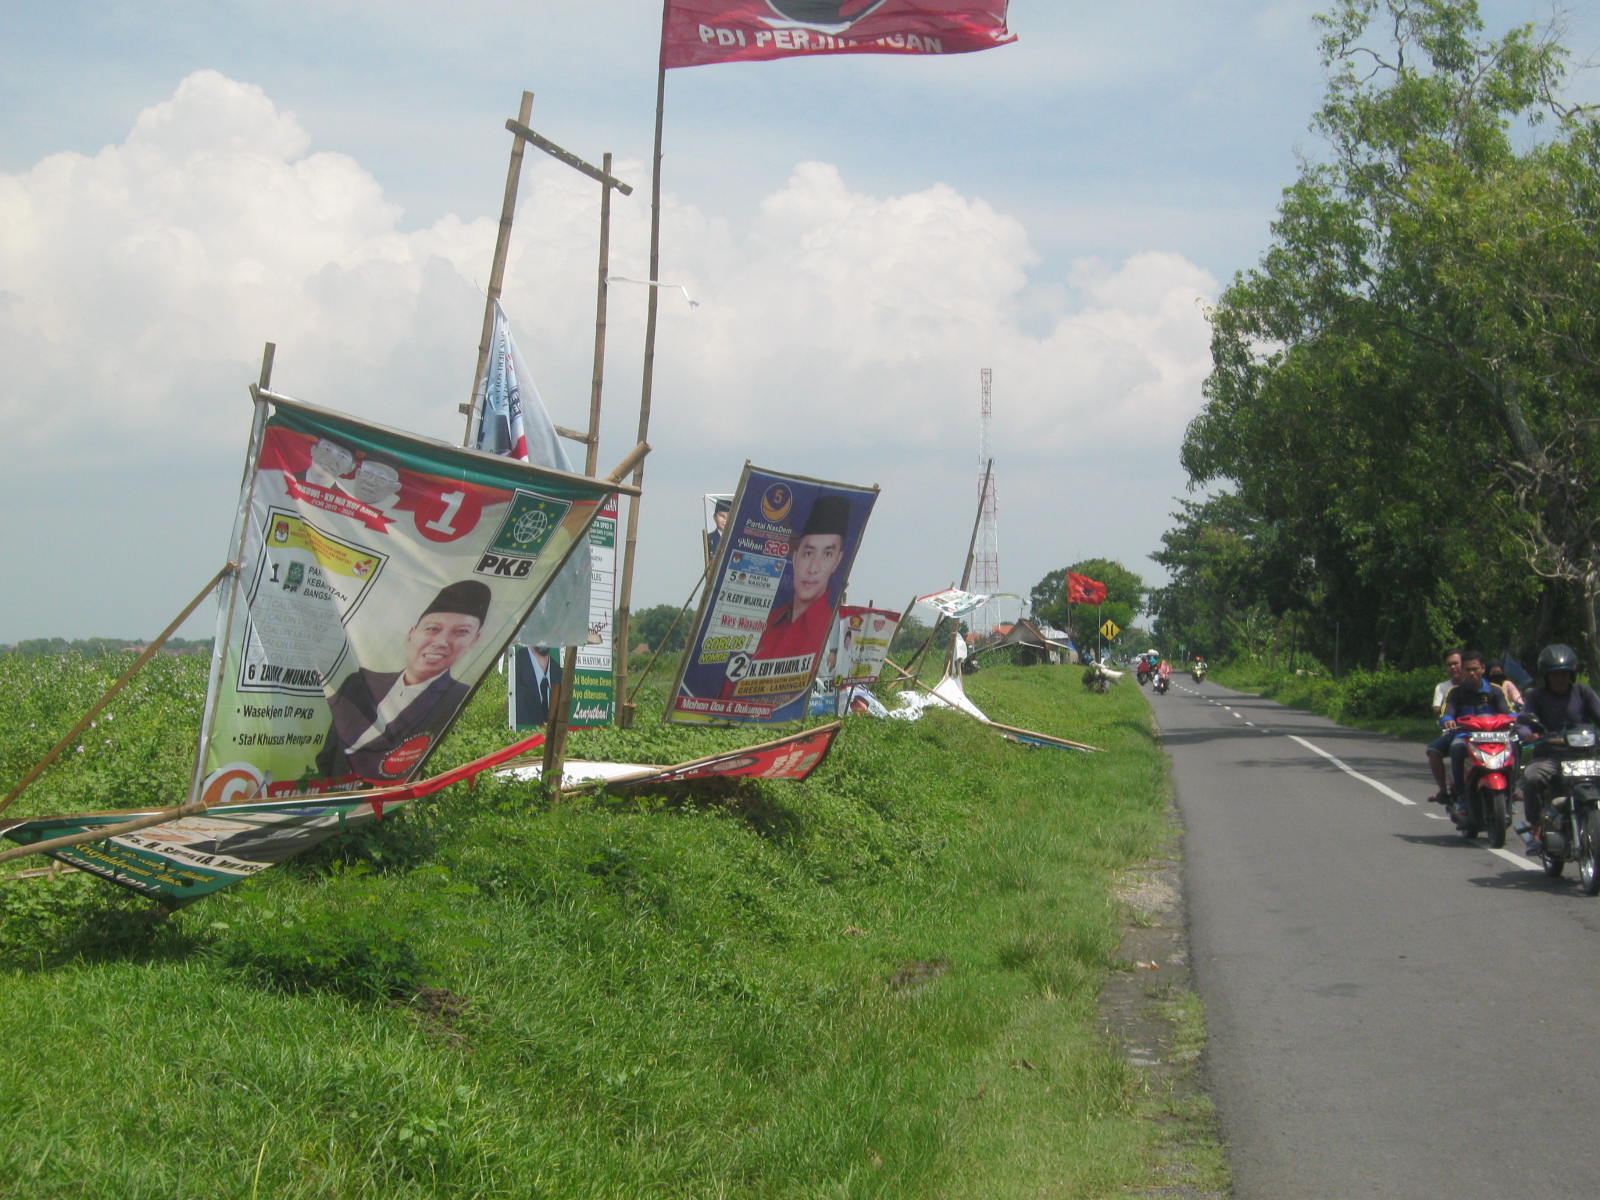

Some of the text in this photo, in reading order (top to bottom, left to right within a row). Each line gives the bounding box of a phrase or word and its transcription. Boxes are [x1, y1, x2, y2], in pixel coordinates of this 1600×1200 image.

[699, 24, 746, 47] PDI
[774, 489, 784, 504] 5
[424, 490, 466, 536] 1
[745, 518, 766, 530] Partai
[766, 523, 793, 535] NasDem
[762, 540, 790, 557] sae
[270, 563, 279, 583] 1
[477, 554, 533, 577] PKB
[729, 571, 737, 582] 5
[719, 590, 726, 601] 2
[702, 634, 745, 651] COBLOS
[248, 664, 256, 680] 6
[730, 656, 746, 678] 2
[757, 661, 773, 677] EDY
[243, 705, 283, 719] Wasekjen
[294, 707, 314, 720] PKB
[680, 698, 709, 709] Mohon
[710, 700, 726, 711] Doa
[734, 702, 771, 718] Dukungan
[239, 733, 257, 746] Staf
[257, 733, 285, 746] Khusus
[312, 734, 324, 745] RI
